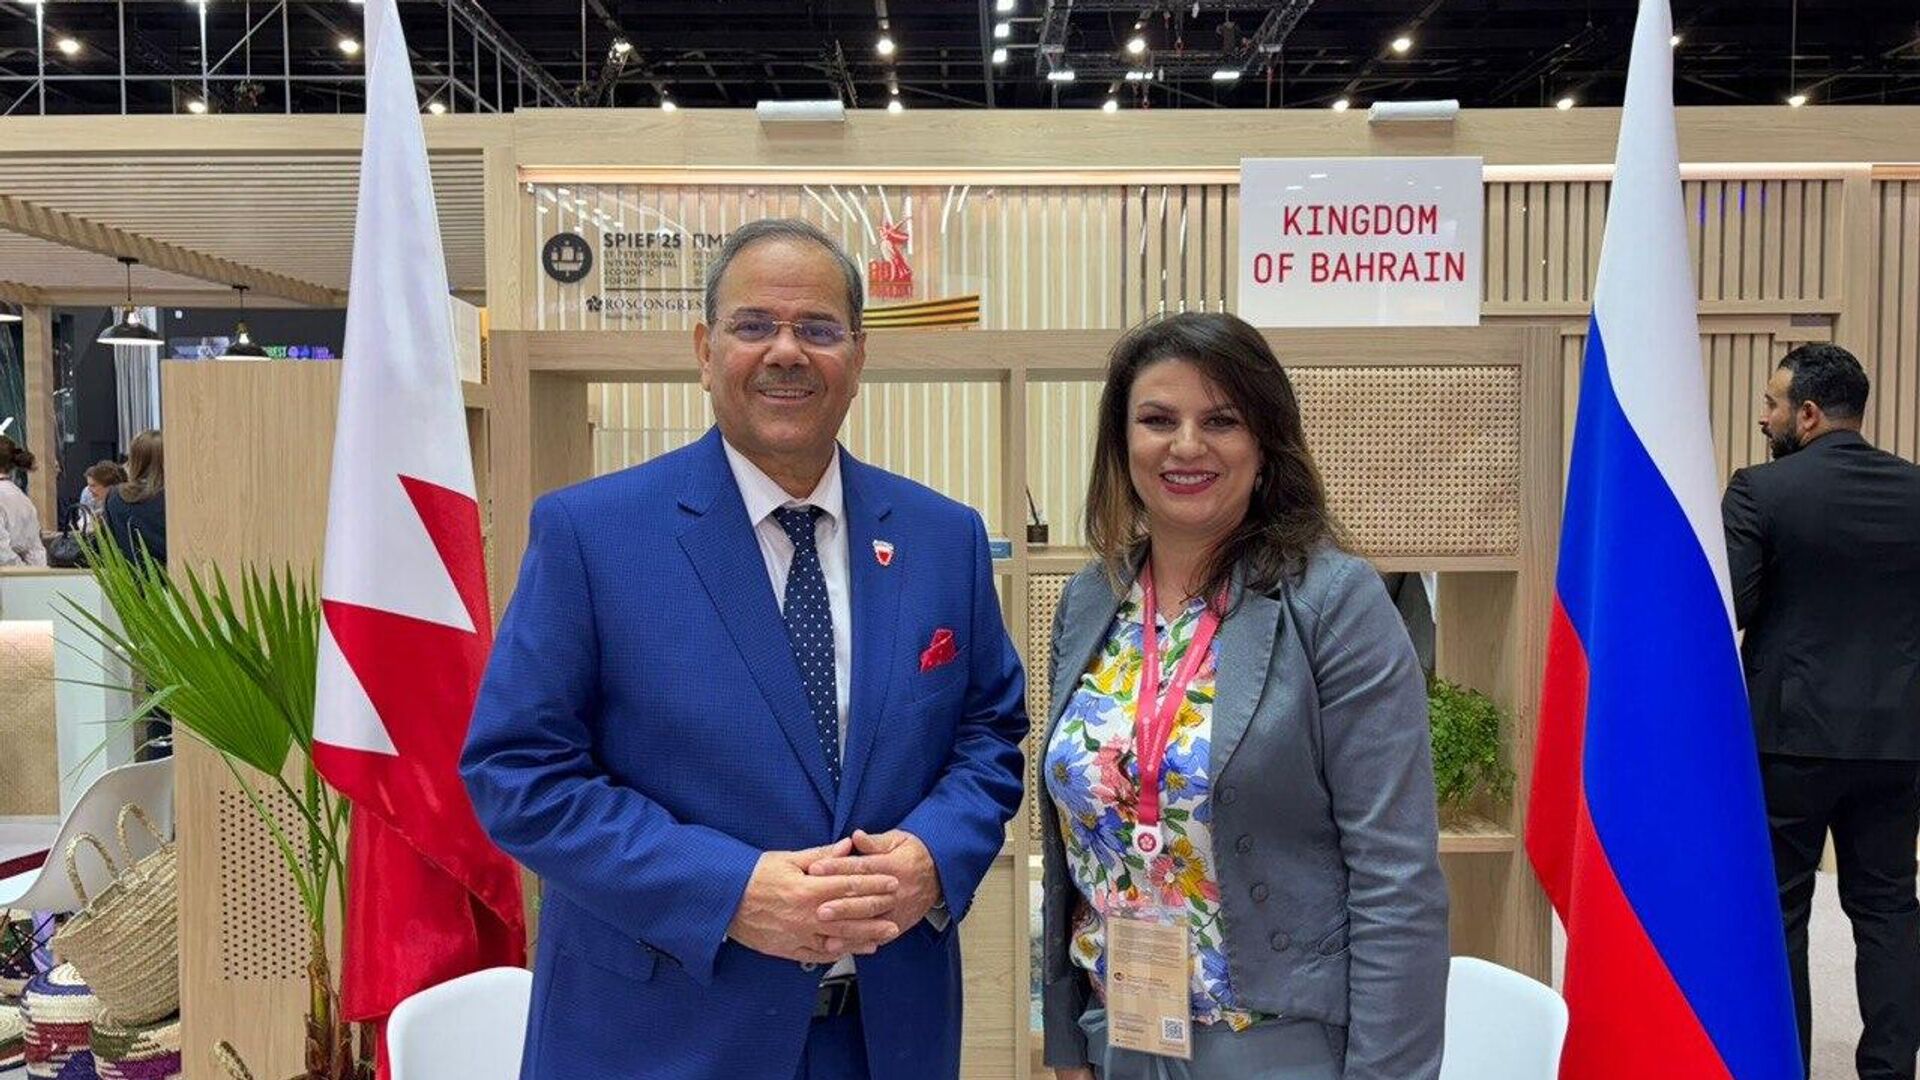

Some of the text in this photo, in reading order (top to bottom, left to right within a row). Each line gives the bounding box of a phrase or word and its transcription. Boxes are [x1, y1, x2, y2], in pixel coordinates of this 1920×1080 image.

[1283, 204, 1438, 236] KINGDOM
[603, 232, 682, 249] SPIEF'25
[1253, 251, 1465, 284] OF BAHRAIN
[604, 298, 704, 312] ROSCONGRES
